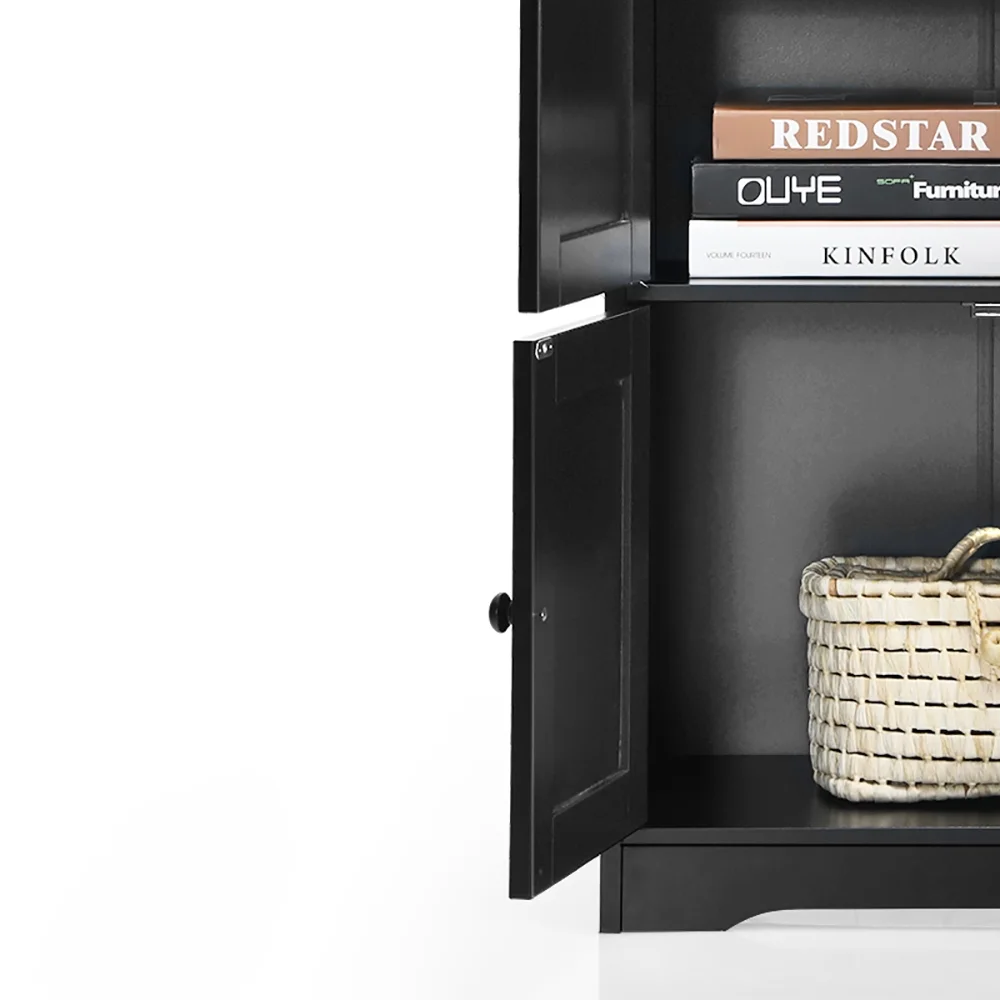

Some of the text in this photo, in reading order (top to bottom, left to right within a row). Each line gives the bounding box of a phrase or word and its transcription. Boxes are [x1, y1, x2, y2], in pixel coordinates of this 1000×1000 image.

[771, 118, 991, 151] REDSTAR
[737, 175, 842, 206] OUYE
[706, 251, 772, 259] VOLUME FOURTEEN
[822, 246, 961, 265] KINFOLK
